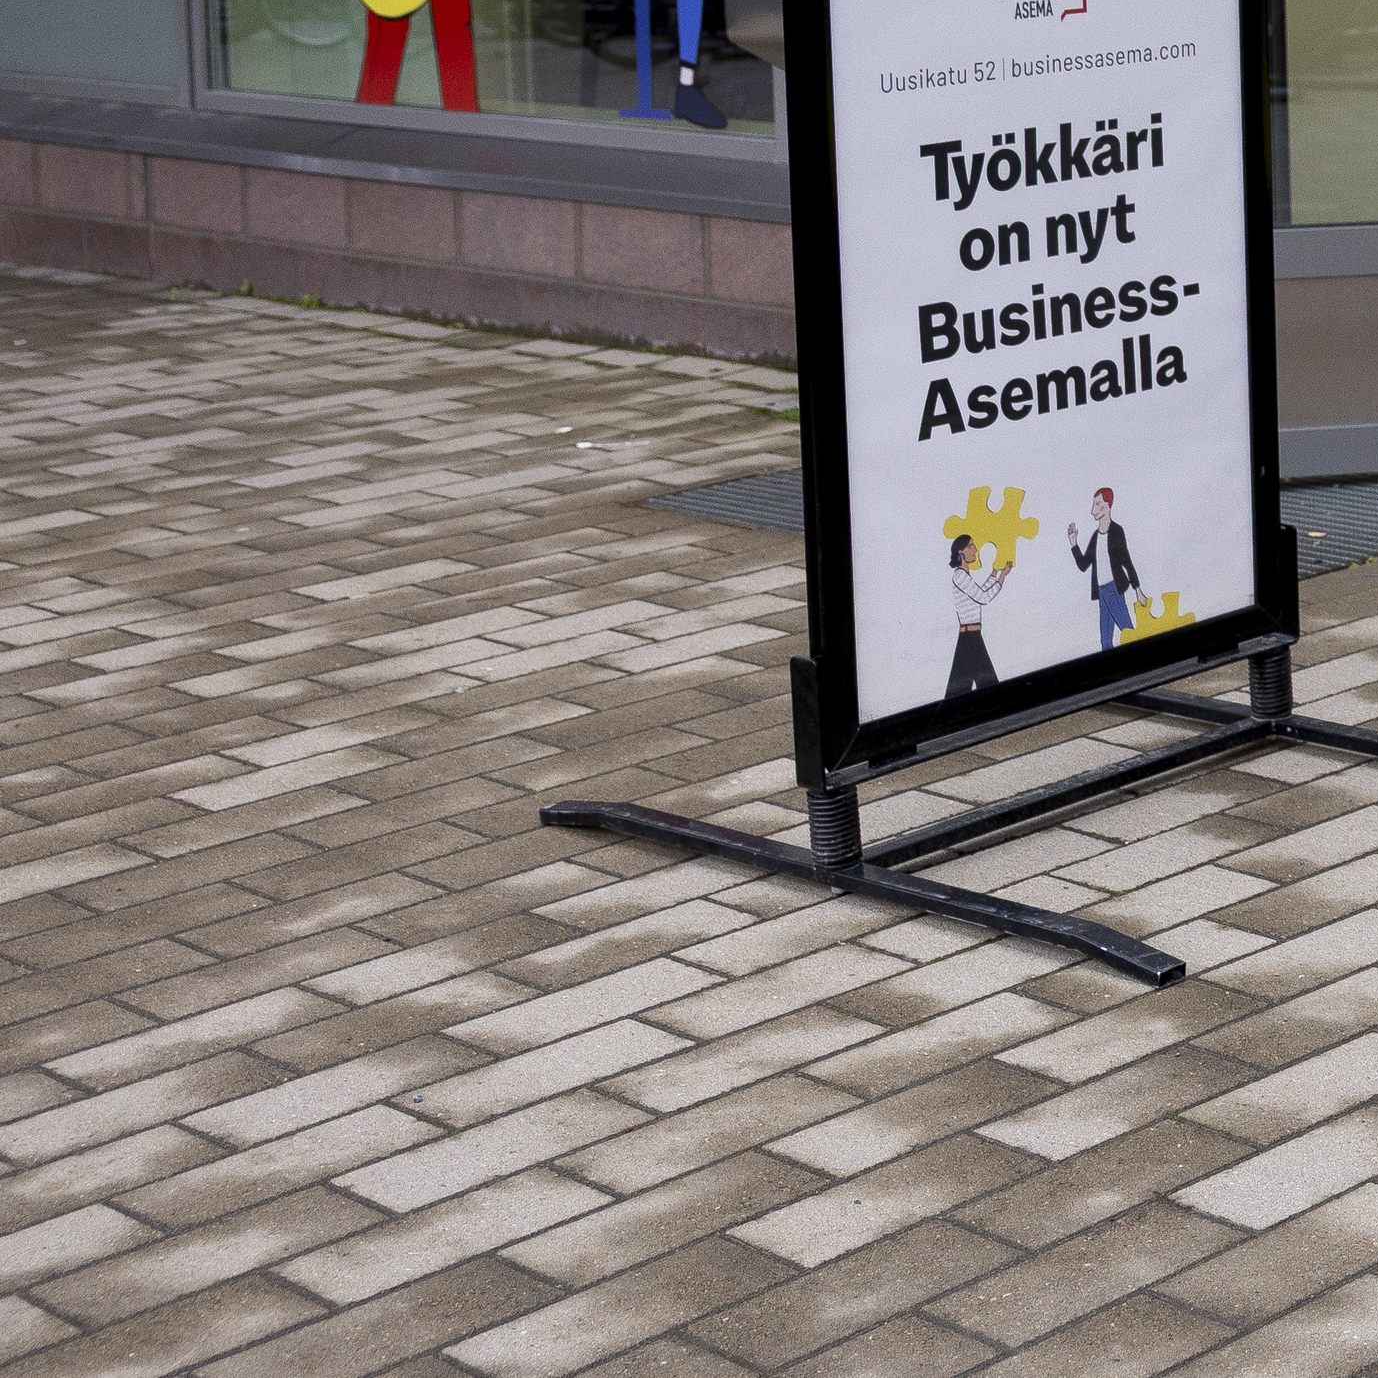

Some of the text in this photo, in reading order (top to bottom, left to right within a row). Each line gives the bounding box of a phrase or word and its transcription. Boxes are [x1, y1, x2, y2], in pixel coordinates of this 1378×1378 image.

[1014, 0, 1055, 21] ASEMA
[879, 64, 968, 95] Uusikatu
[973, 60, 997, 83] 52
[1010, 39, 1197, 79] businessasema.com
[919, 112, 1164, 211] Työkkäri
[959, 194, 1136, 272] on nyt
[917, 273, 1201, 364] Business-
[917, 334, 1188, 442] Asemalla
